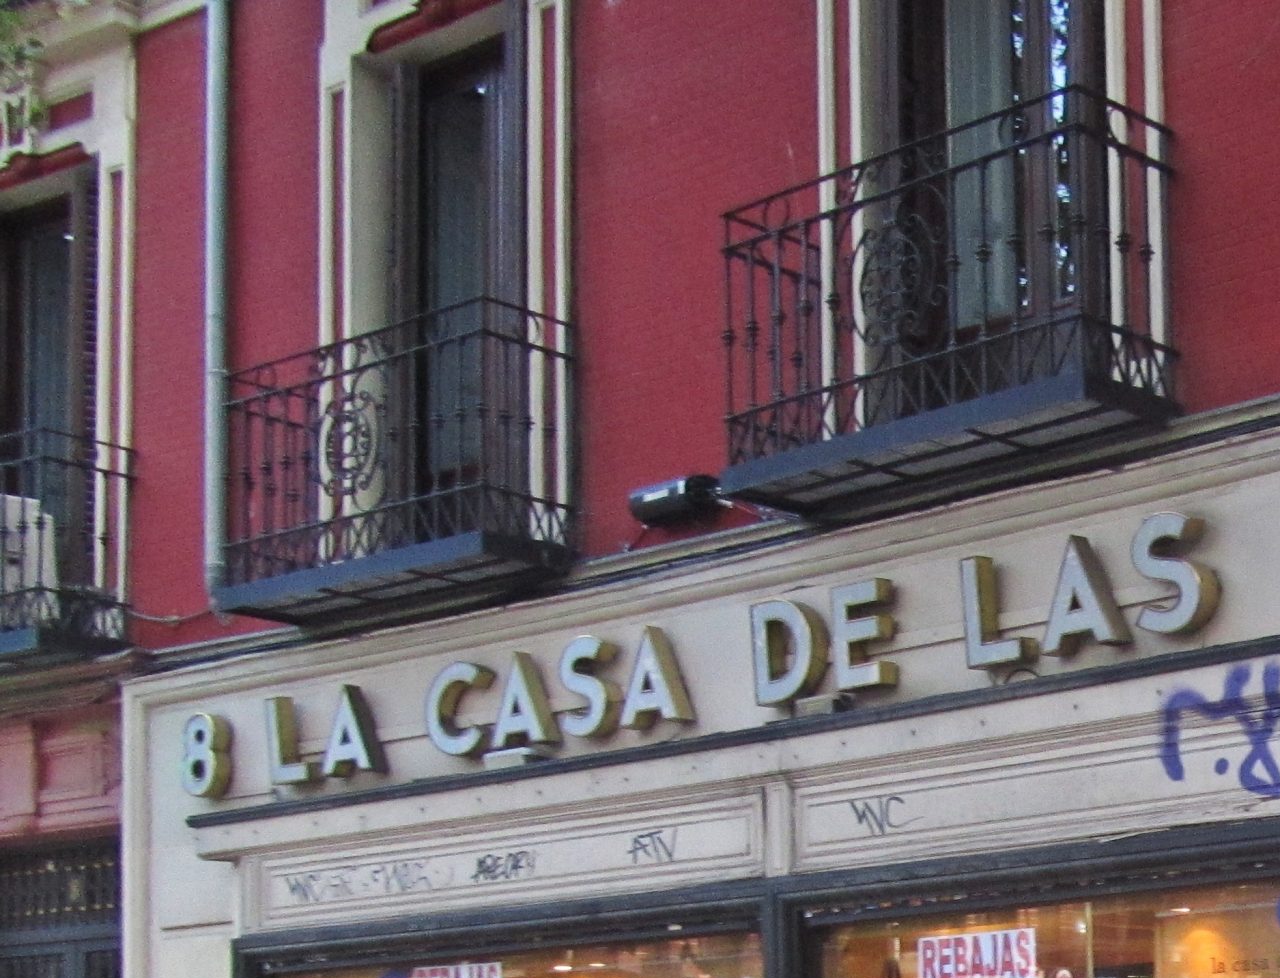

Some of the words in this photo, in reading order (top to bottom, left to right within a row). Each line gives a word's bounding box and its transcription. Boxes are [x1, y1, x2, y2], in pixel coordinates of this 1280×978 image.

[182, 711, 232, 799] 8
[265, 683, 388, 786] LA
[424, 624, 696, 758] CASA
[749, 577, 899, 707] DE
[960, 511, 1223, 671] LAS
[1211, 957, 1226, 974] la
